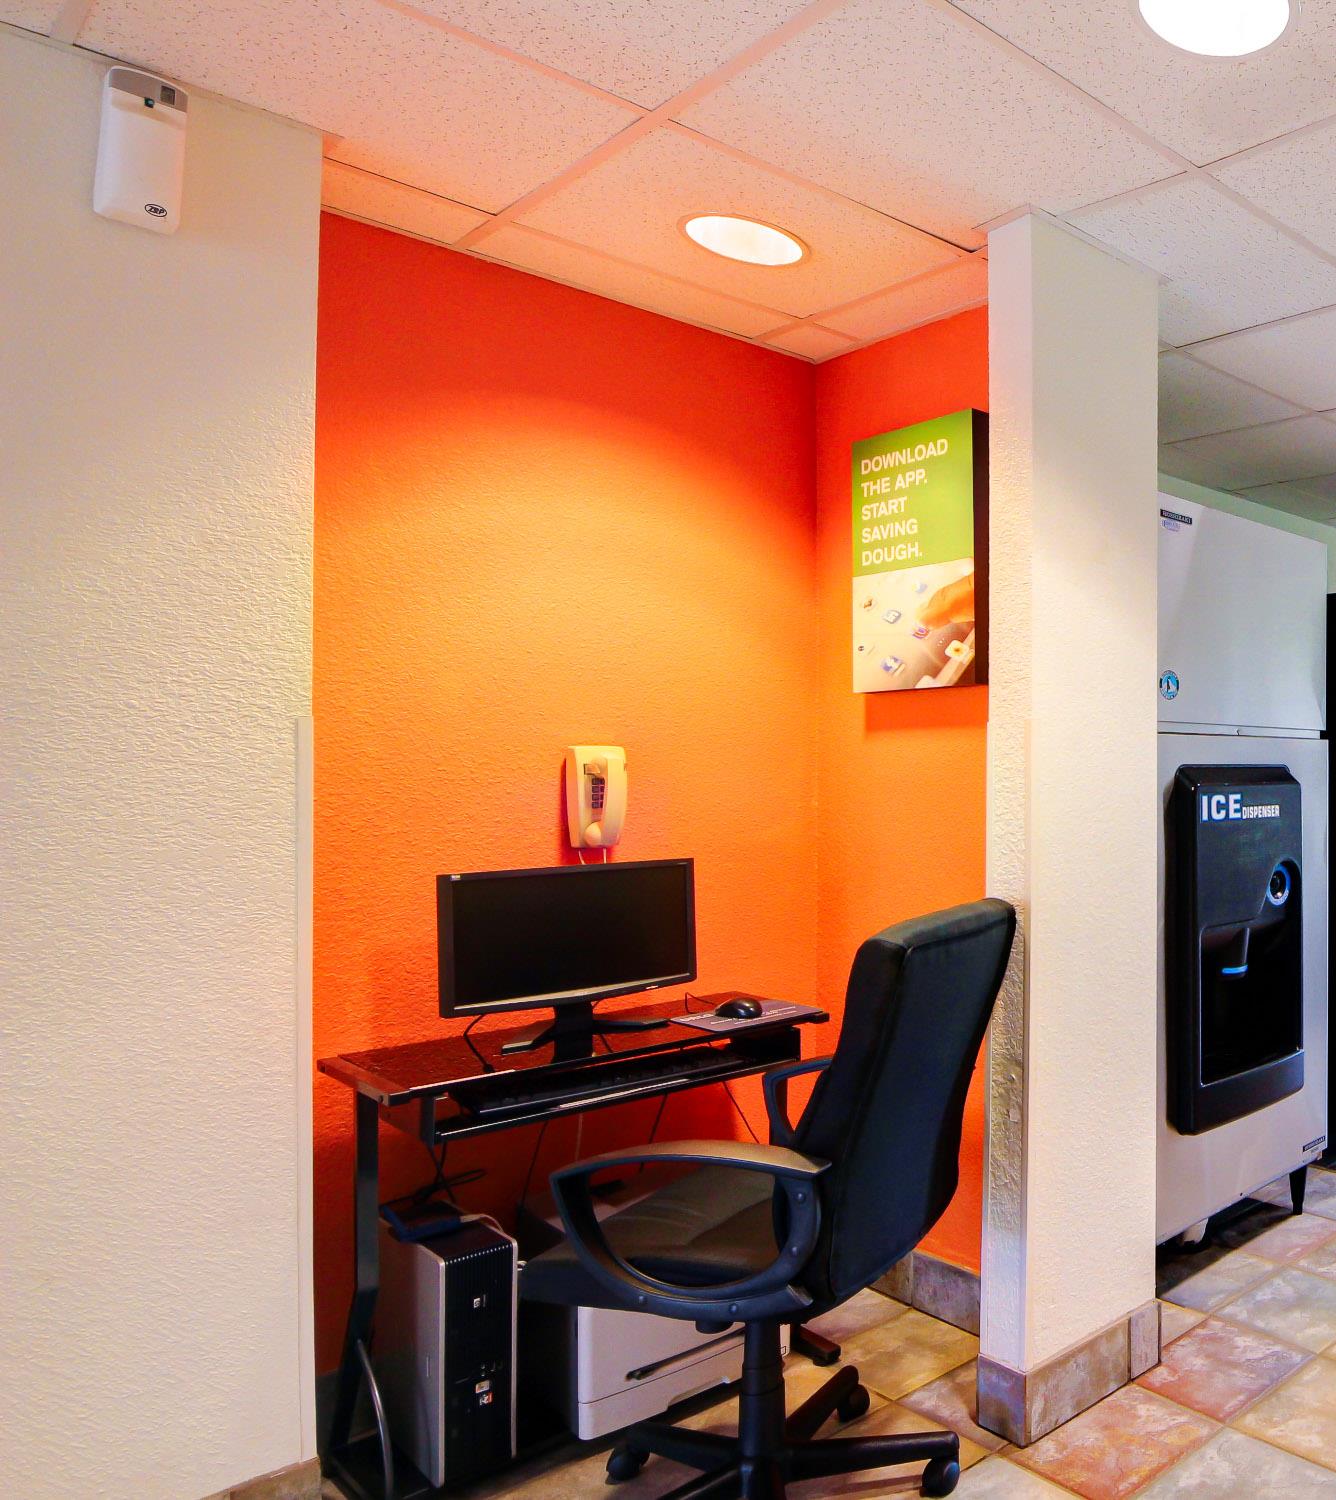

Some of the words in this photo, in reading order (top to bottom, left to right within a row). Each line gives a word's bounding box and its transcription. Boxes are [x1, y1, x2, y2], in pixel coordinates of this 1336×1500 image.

[861, 438, 948, 475] DOWNLOAD
[861, 477, 891, 498] THE
[895, 468, 928, 491] APP.
[861, 496, 907, 520] START
[861, 518, 918, 543] SAVING
[861, 541, 922, 566] DOUGH.
[1200, 793, 1242, 822] ICE
[1242, 804, 1280, 820] DISPENSER
